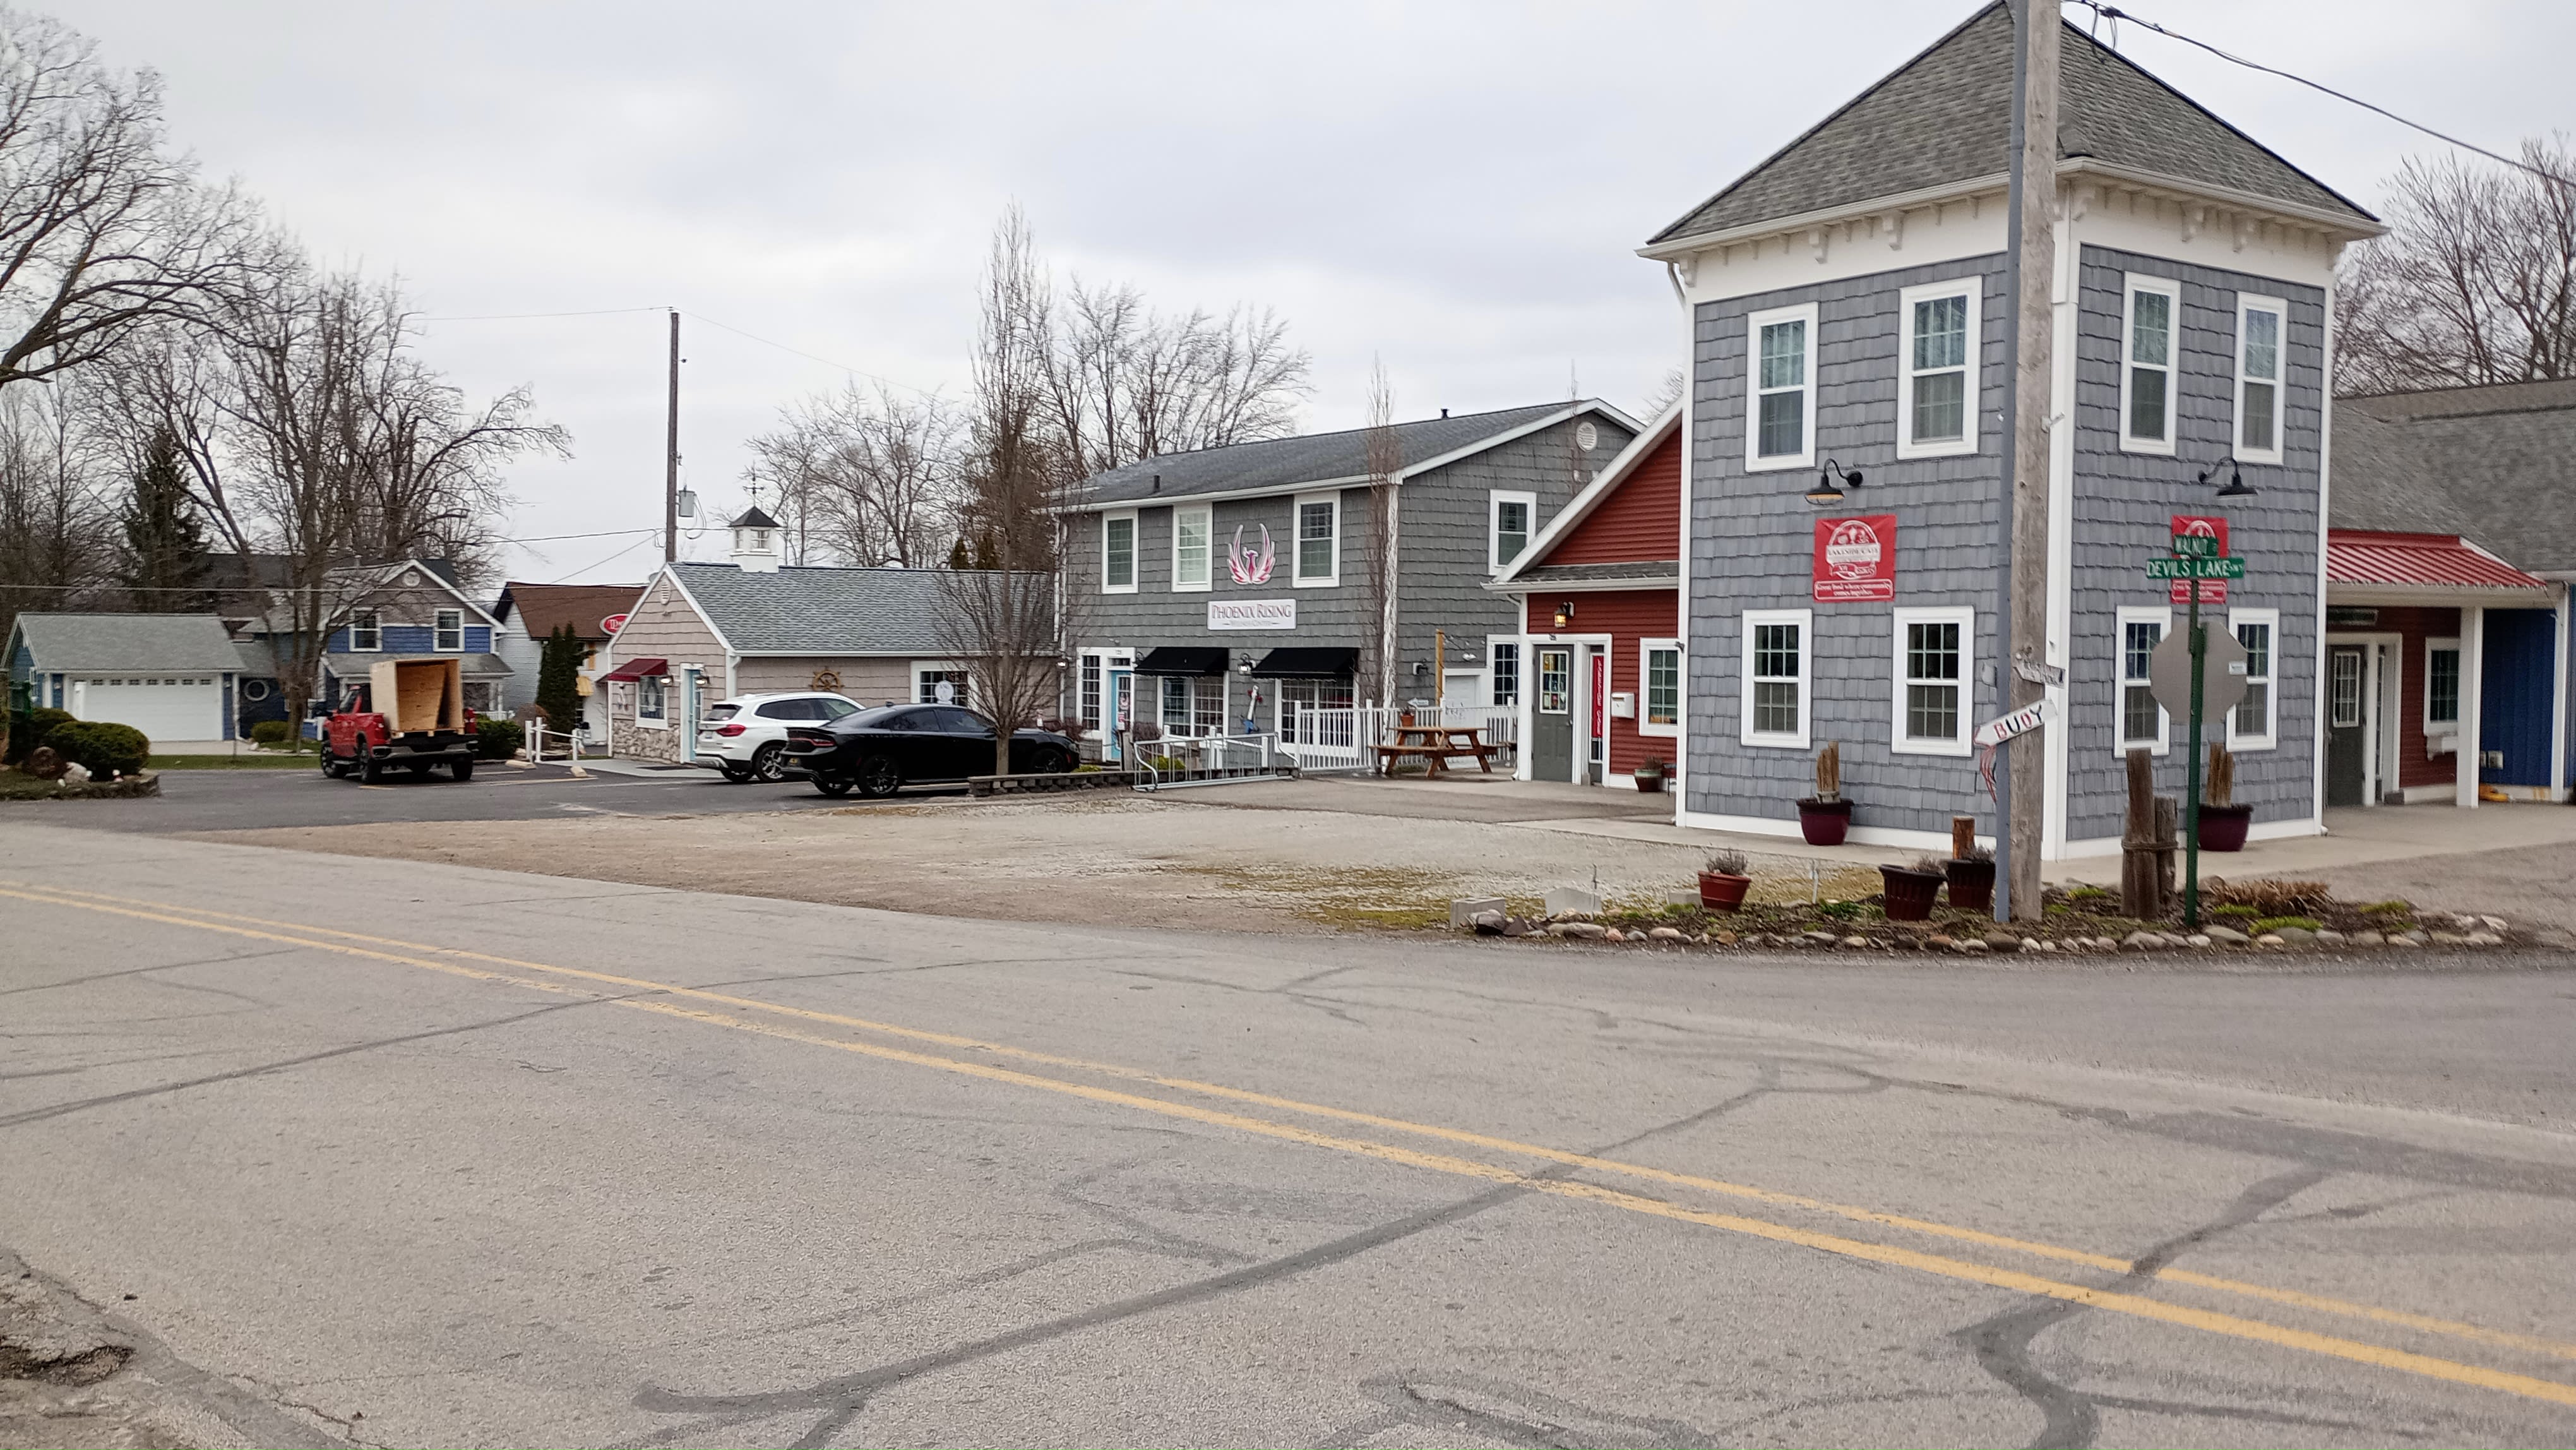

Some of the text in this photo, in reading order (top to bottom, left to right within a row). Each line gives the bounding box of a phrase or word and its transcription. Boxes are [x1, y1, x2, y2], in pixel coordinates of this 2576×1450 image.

[2147, 560, 2191, 577] DEVILS
[2197, 560, 2230, 577] LAKE
[1212, 603, 1292, 619] PHOENIX RISING
[1993, 704, 2043, 741] BUOY
